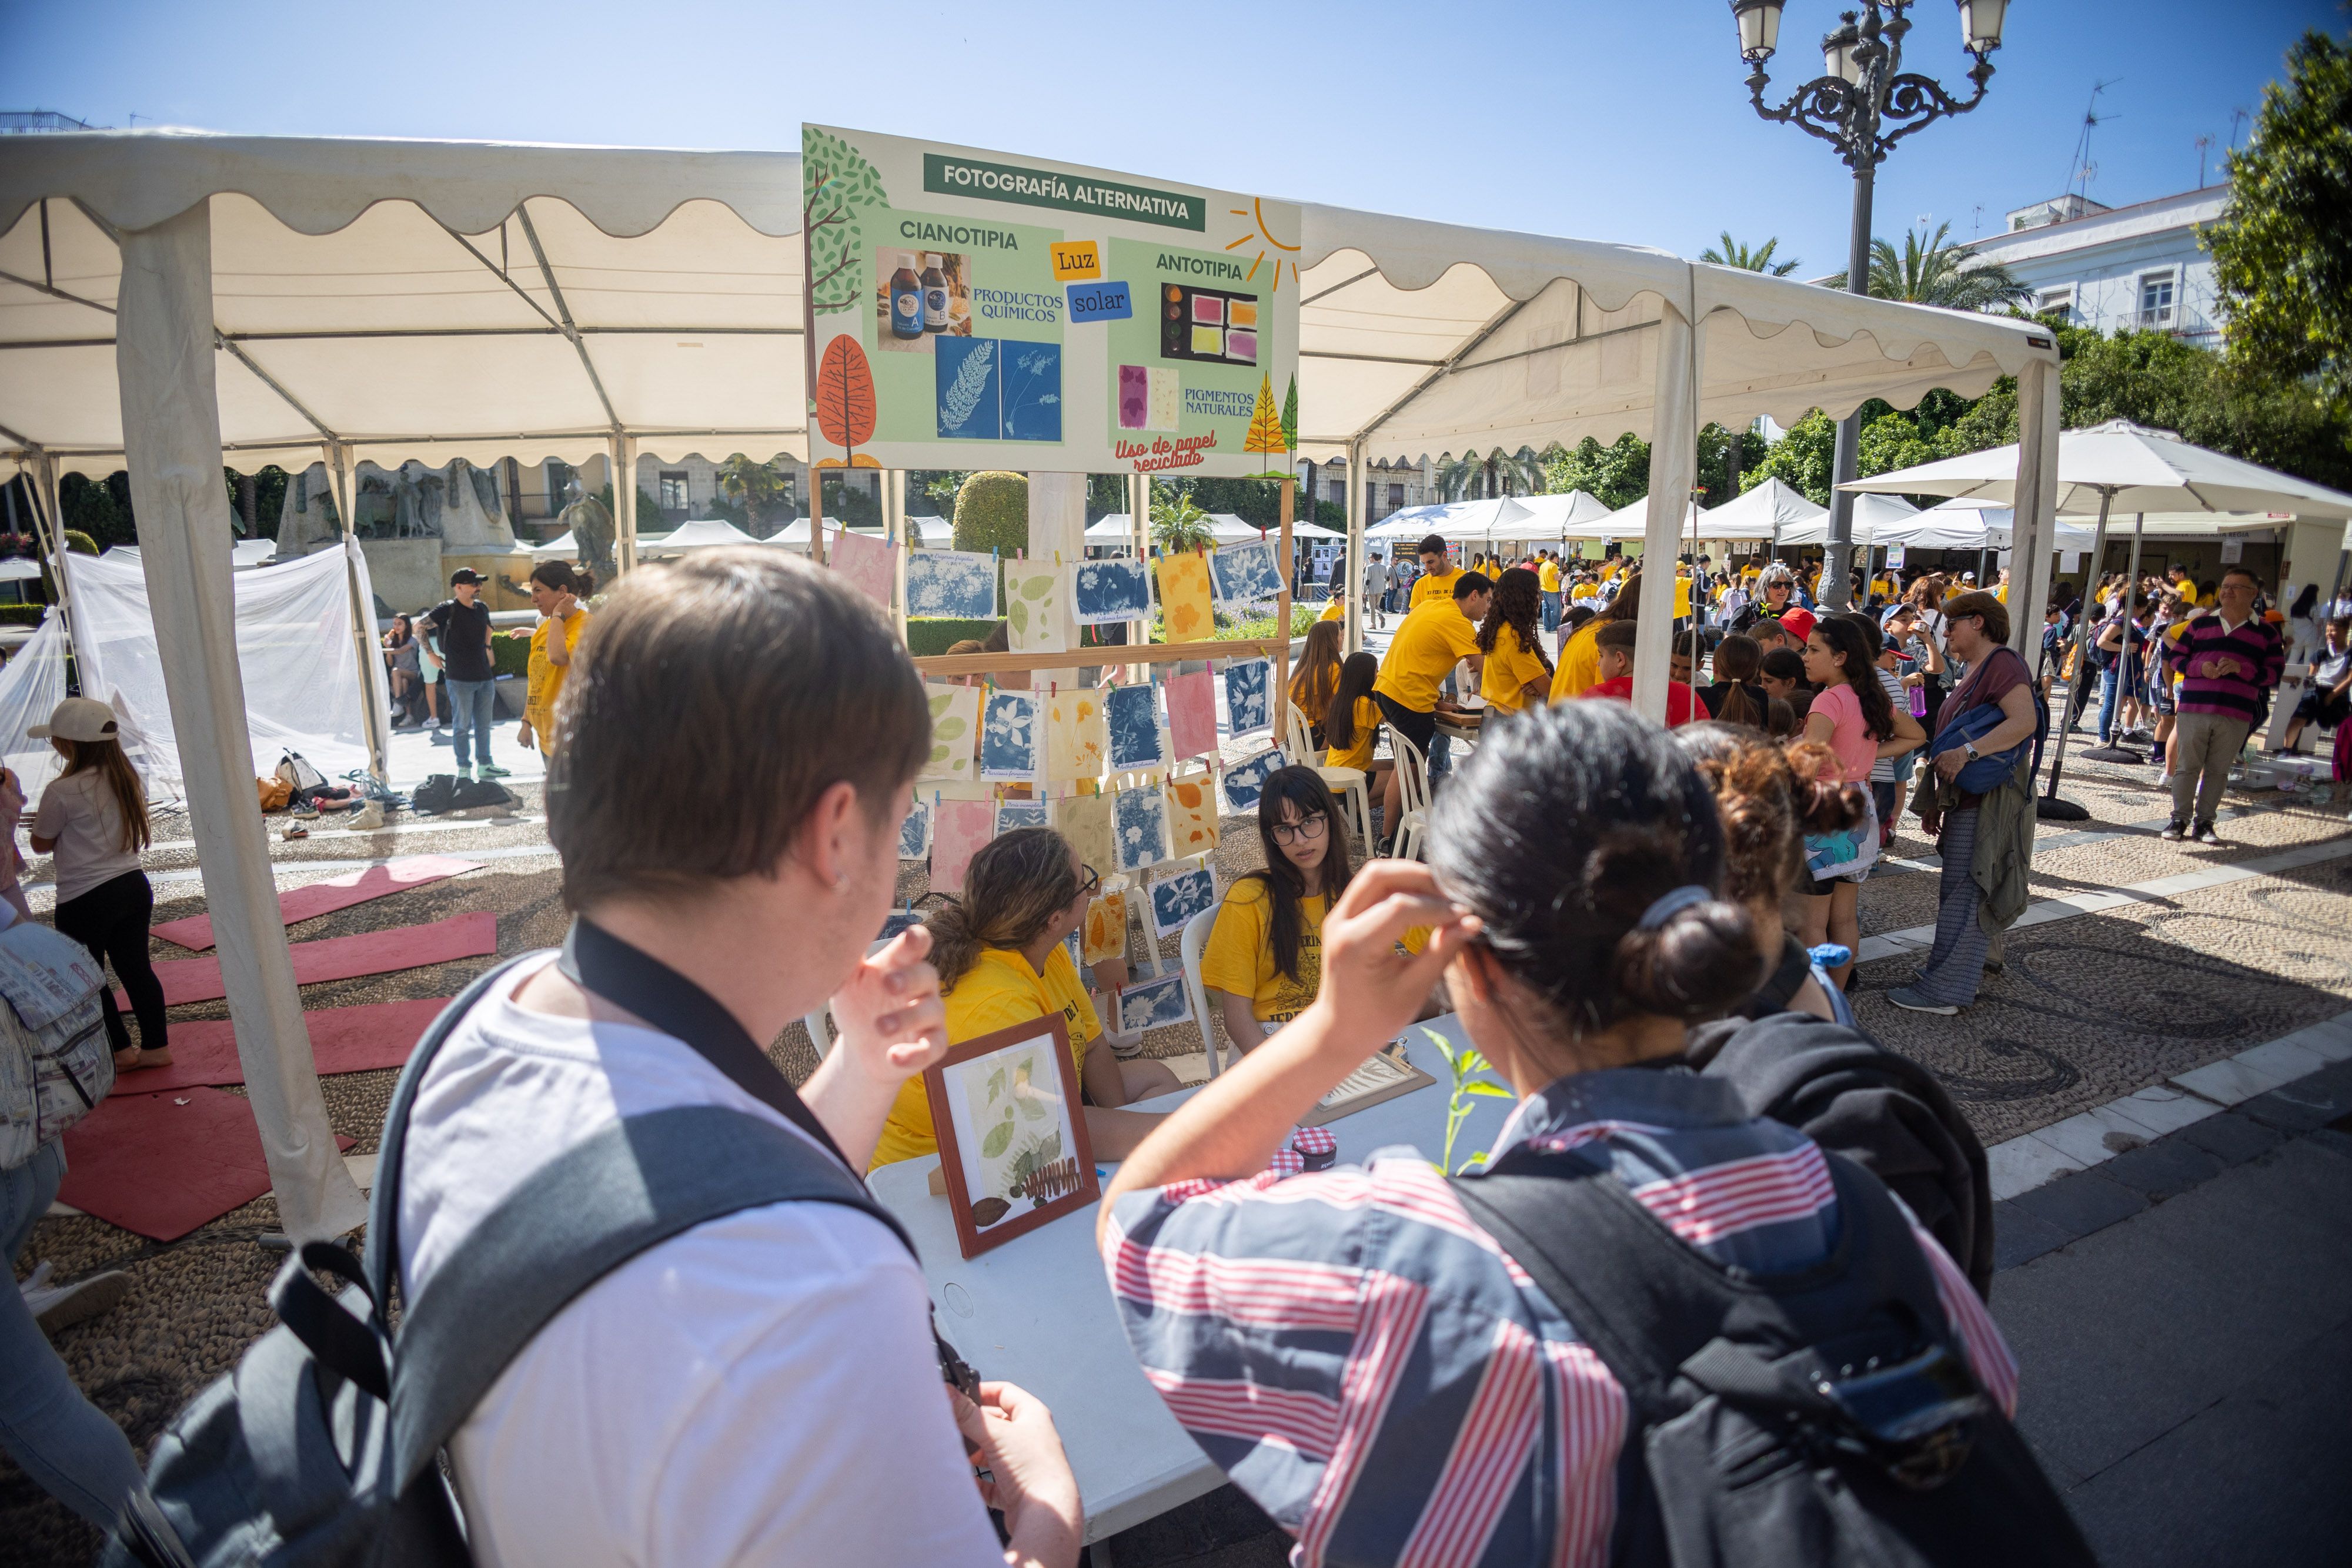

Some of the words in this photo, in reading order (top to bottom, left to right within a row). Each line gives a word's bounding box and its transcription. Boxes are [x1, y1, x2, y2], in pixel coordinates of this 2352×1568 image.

[944, 165, 1070, 200] FOTOGRAFÍA
[1073, 185, 1190, 219] ALTERNATIVA
[900, 220, 1018, 250] CIANOTIPIA
[1058, 252, 1095, 270] Luz
[1156, 253, 1242, 280] ANTOTIPIA
[973, 288, 1064, 309] PRODUCTOS
[1075, 290, 1125, 313] solar
[911, 317, 918, 327] A
[940, 311, 946, 320] B
[981, 303, 1056, 323] QUÍMICOS
[1185, 389, 1255, 404] PIGMENTOS
[1186, 402, 1253, 417] NATURALES
[1115, 440, 1148, 459] Uso
[1151, 436, 1172, 456] de
[1175, 429, 1217, 456] papel
[1134, 450, 1204, 472] reciclado
